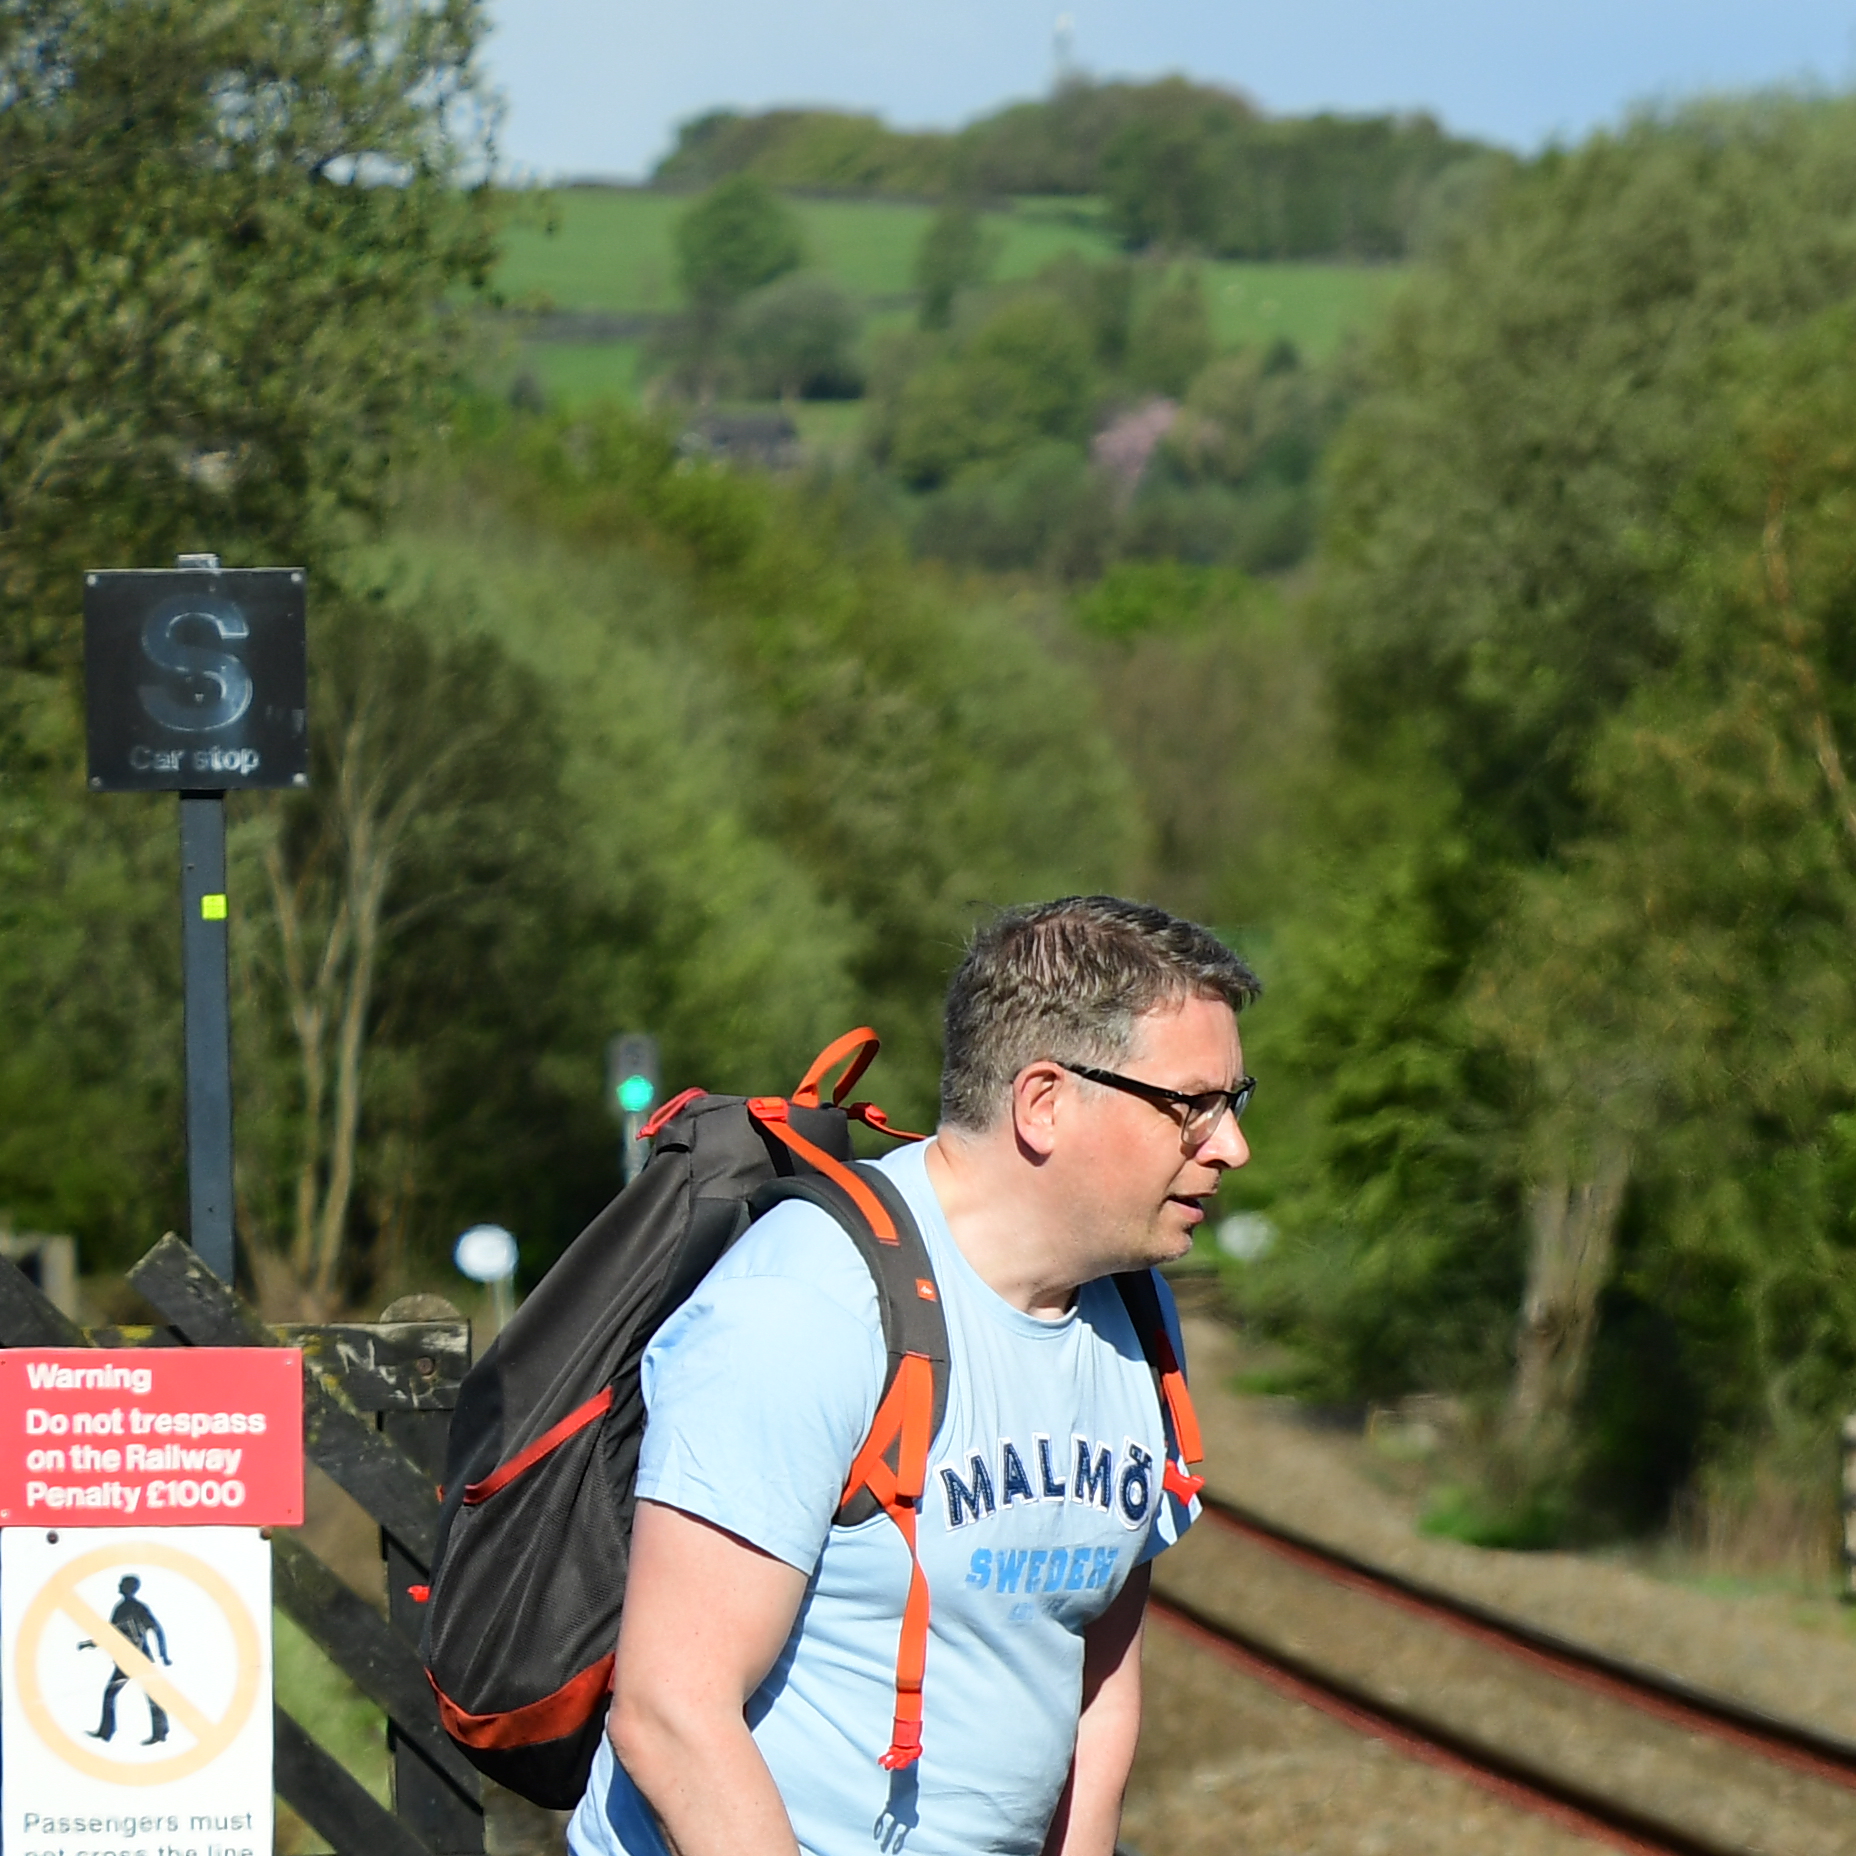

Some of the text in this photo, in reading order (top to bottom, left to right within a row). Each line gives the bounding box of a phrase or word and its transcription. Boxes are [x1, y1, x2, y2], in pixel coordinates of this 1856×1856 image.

[138, 596, 253, 732] S
[129, 747, 260, 775] Car stop
[26, 1363, 152, 1394] Warning
[26, 1407, 267, 1439] Do not trespass
[26, 1443, 242, 1477] on the Railway
[26, 1479, 246, 1513] Penalty £1000
[934, 1432, 1154, 1531] MALMÖ
[965, 1546, 1118, 1594] SWEDEN
[23, 1812, 252, 1838] Passengers must
